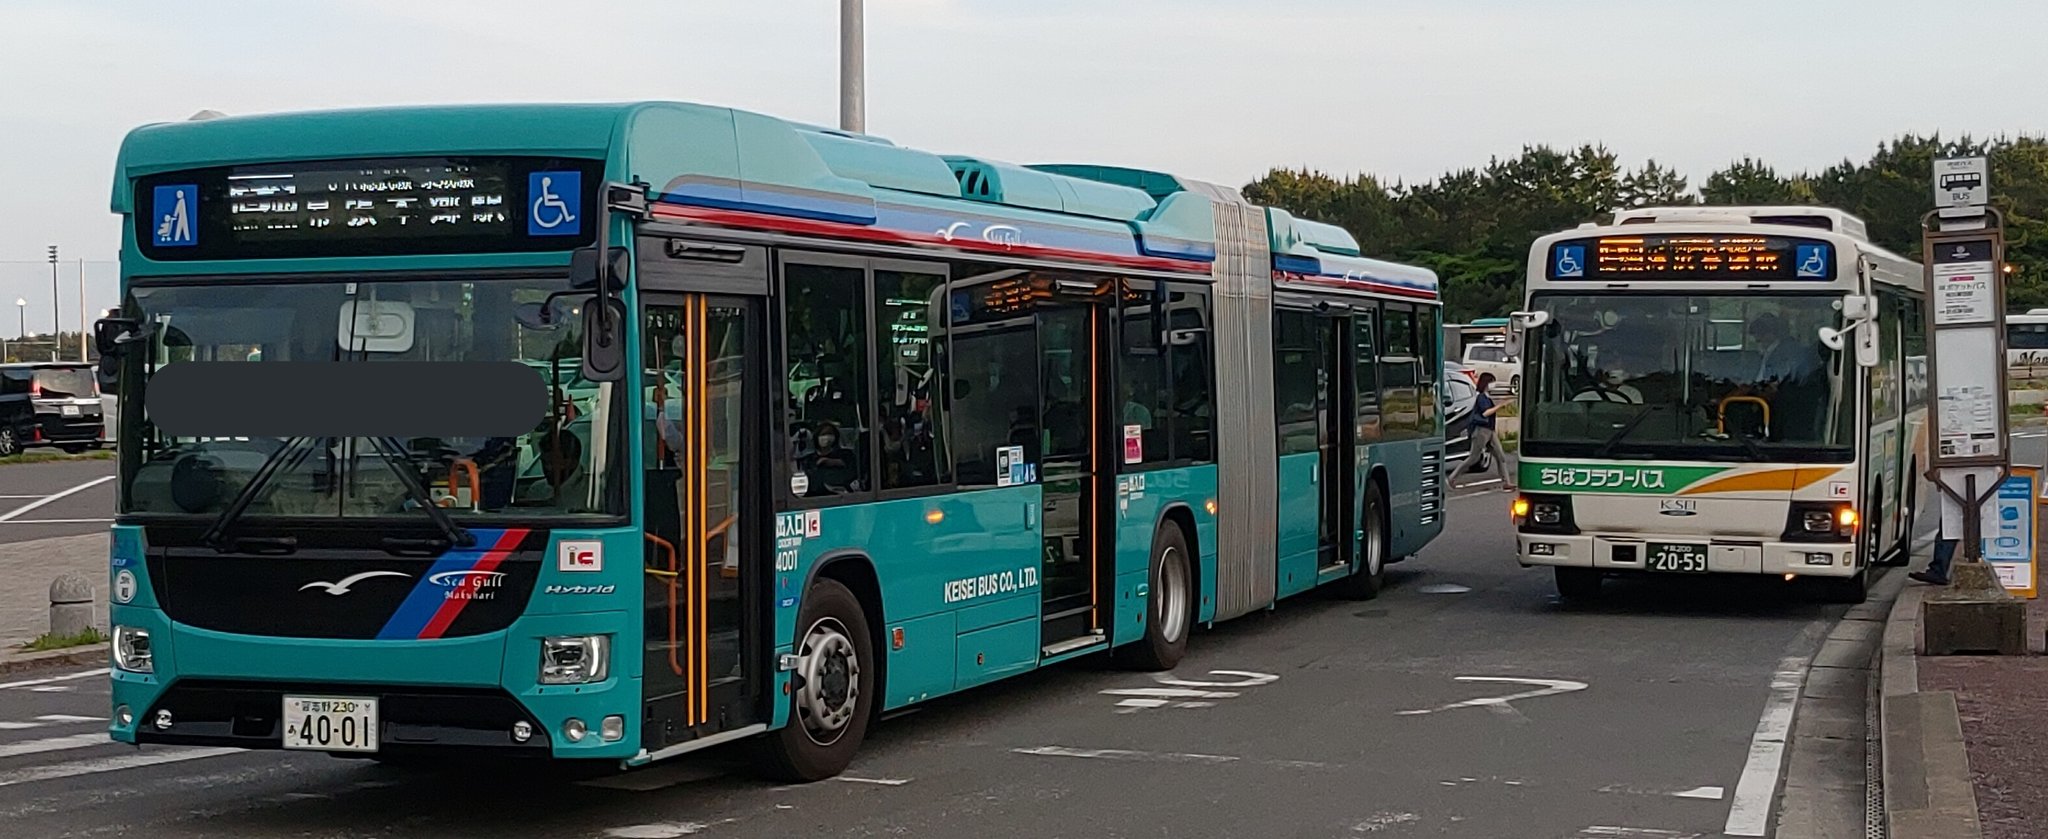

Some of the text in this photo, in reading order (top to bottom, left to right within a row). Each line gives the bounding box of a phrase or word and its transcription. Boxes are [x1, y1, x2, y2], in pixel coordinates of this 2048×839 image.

[1952, 192, 1971, 201] BUS
[1541, 468, 1665, 488] ちばフラワーバス
[775, 550, 798, 572] 4001
[1656, 552, 1706, 571] 20-59
[472, 574, 505, 592] Gull
[545, 584, 616, 595] Hybrid
[944, 566, 1038, 604] KEISEI BUS CO., LTD.
[300, 714, 369, 747] 40-01
